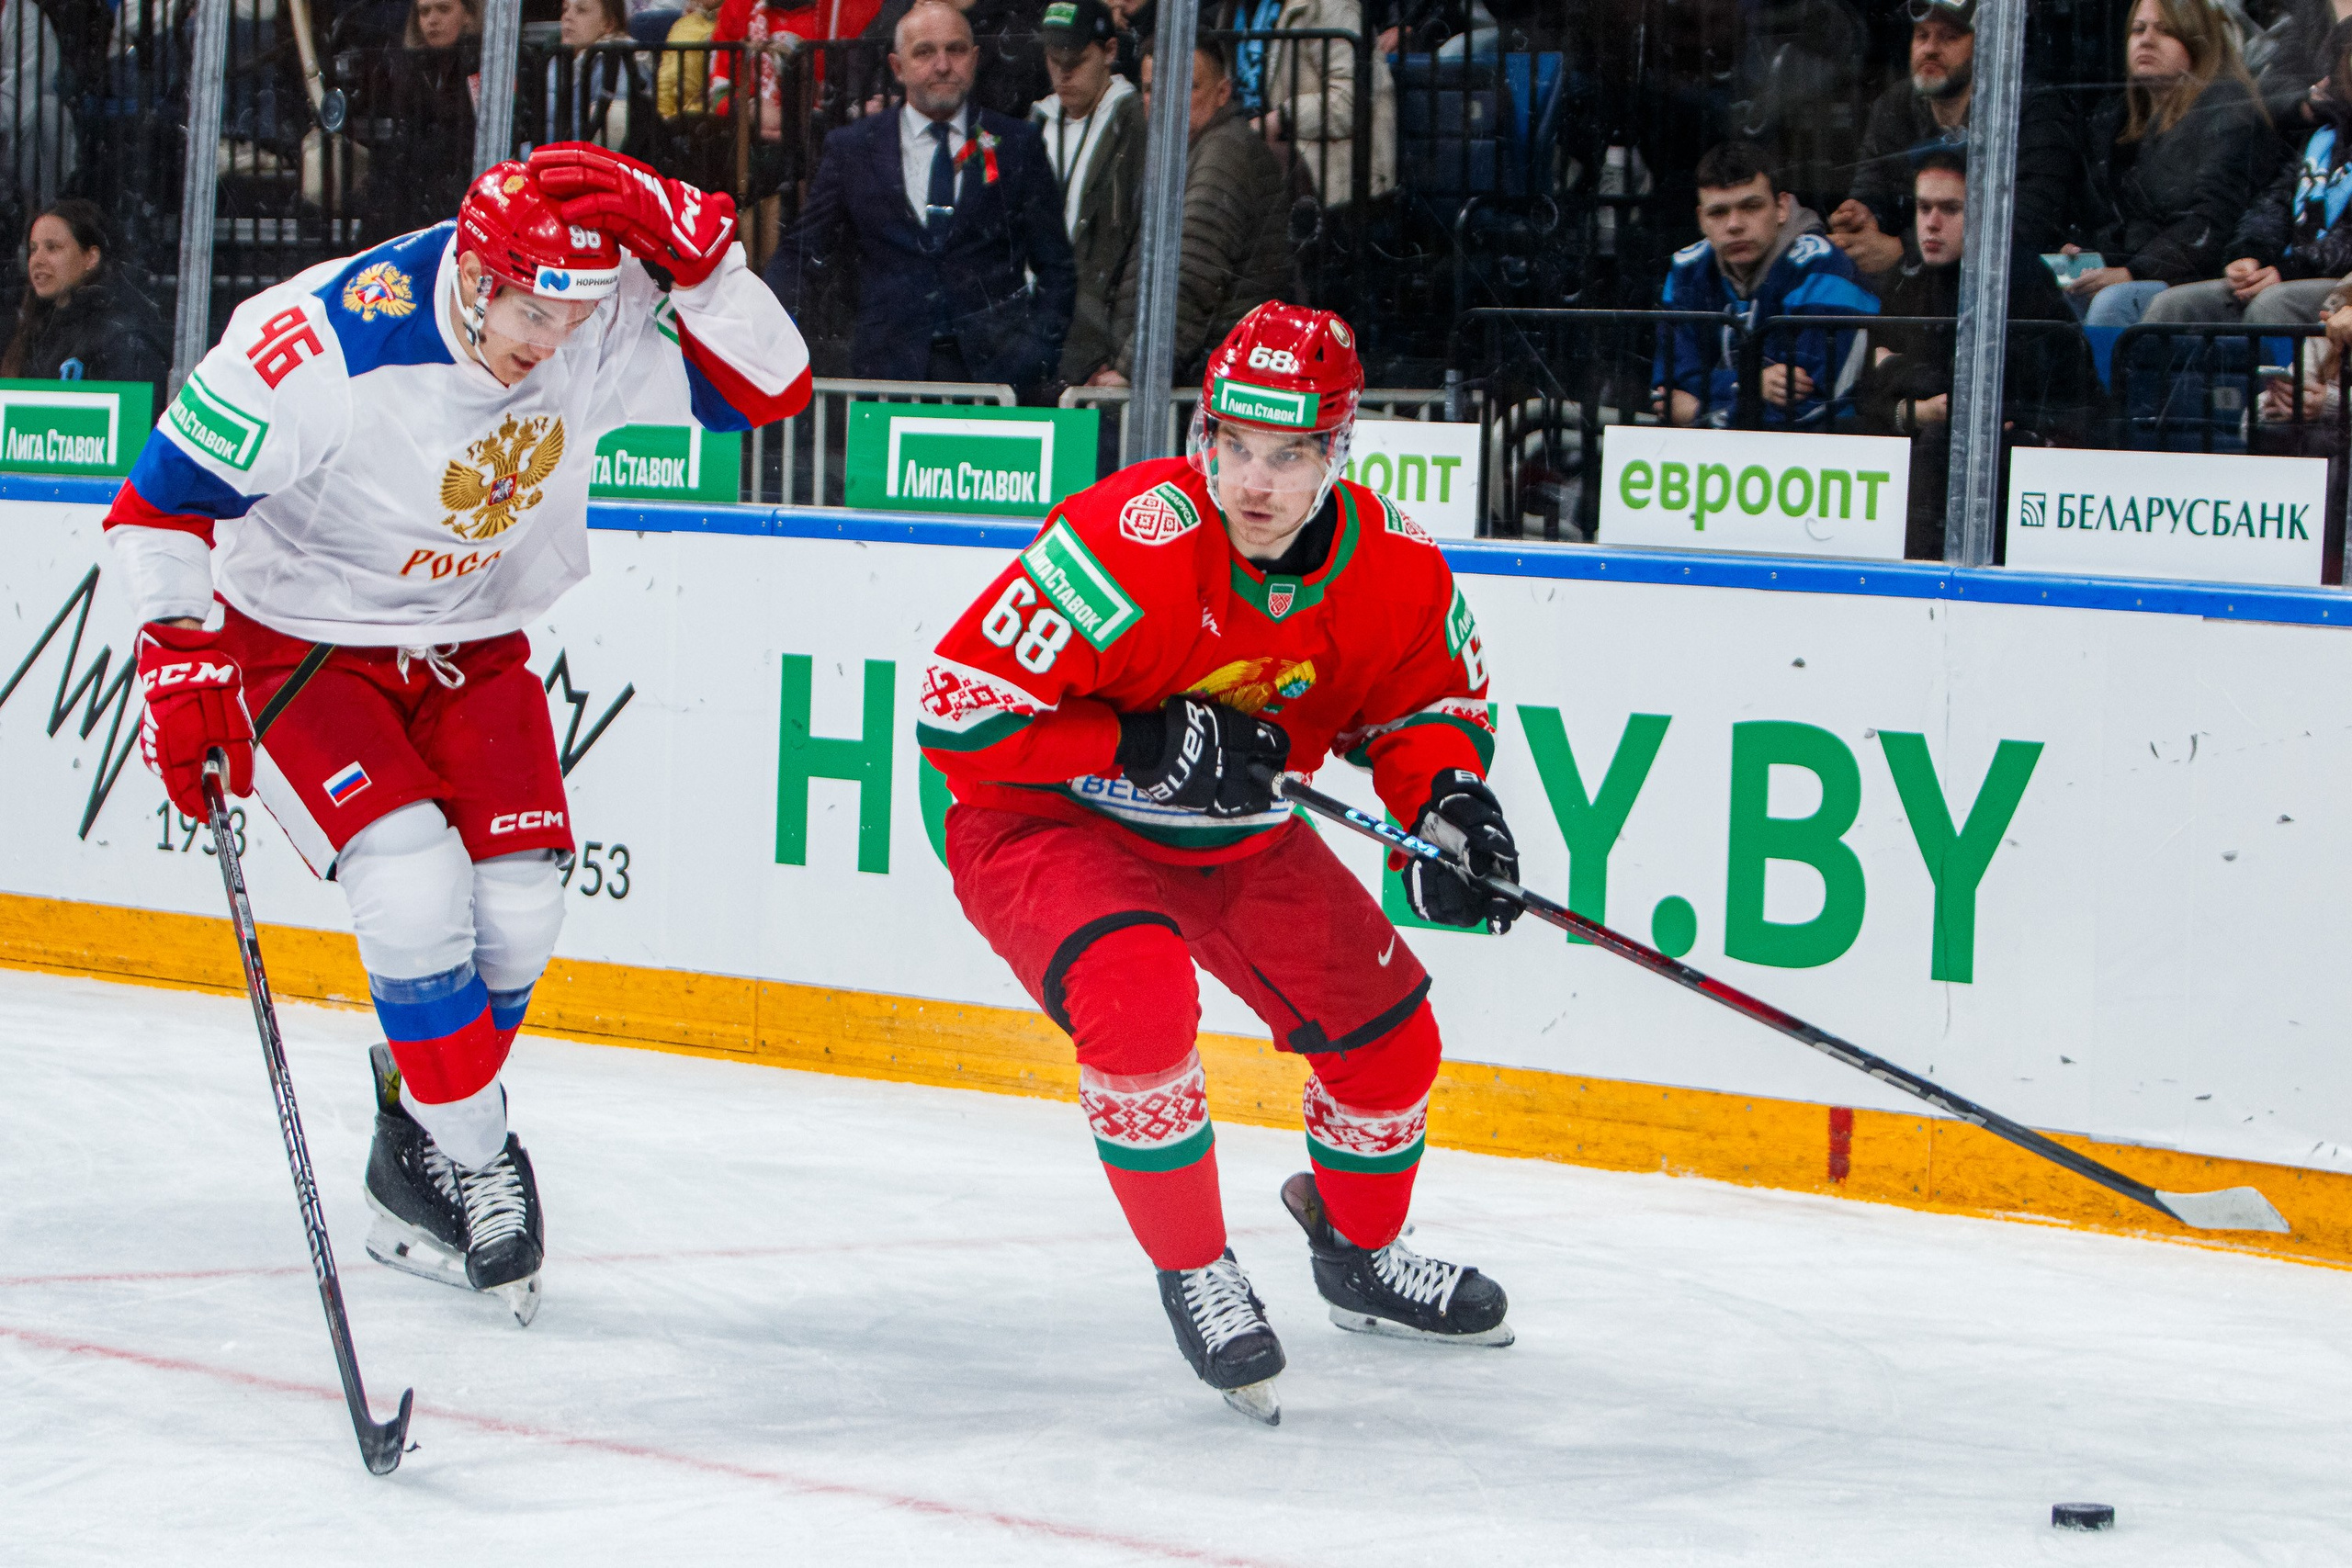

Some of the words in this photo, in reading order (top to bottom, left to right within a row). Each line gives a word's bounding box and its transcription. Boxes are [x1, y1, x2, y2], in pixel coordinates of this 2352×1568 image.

[464, 219, 489, 243] CCM
[569, 224, 602, 250] 96
[246, 305, 324, 390] 96
[1248, 346, 1295, 374] 68
[1619, 458, 1891, 531] евроопт
[2056, 491, 2311, 541] БЕЛАРУСБАНК
[981, 576, 1073, 675] 68
[141, 660, 233, 692] CCM
[1148, 699, 1206, 802] AUER
[490, 809, 564, 835] CCM
[1344, 807, 1440, 859] CCM
[221, 828, 244, 888] SHERWOOD
